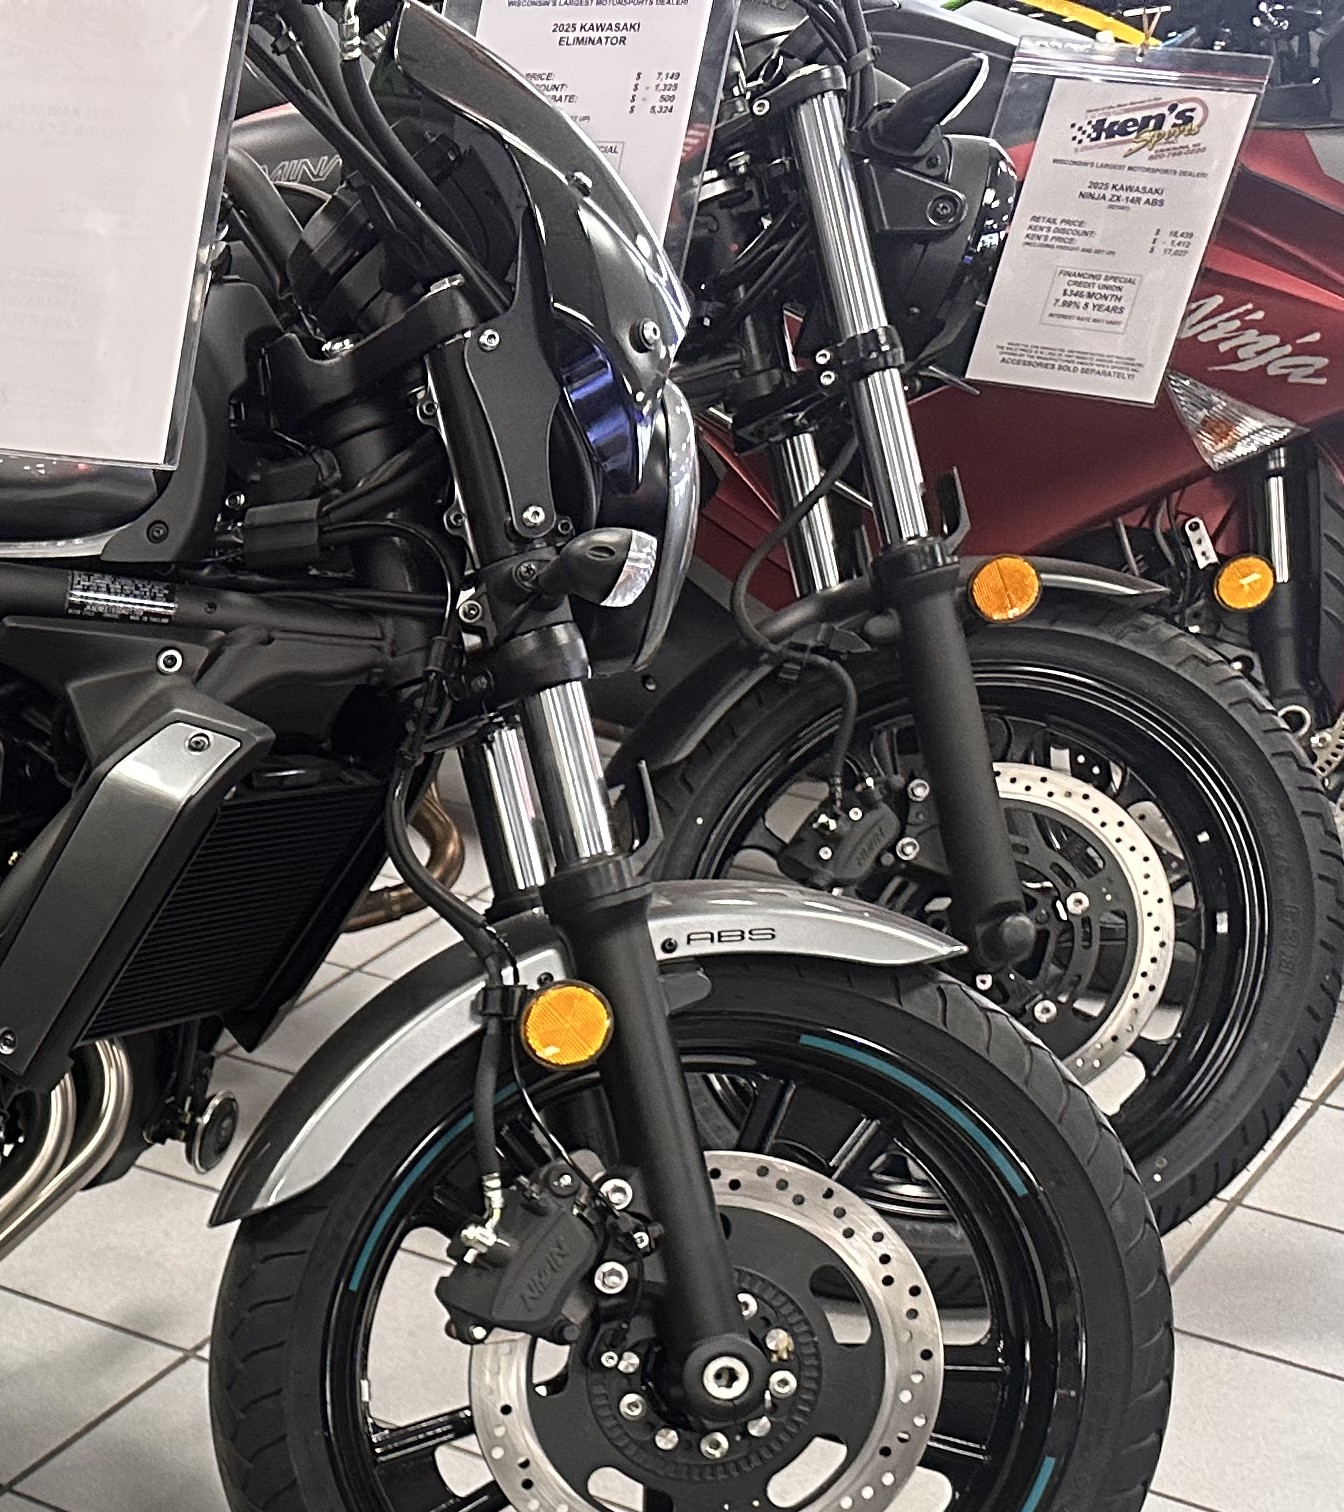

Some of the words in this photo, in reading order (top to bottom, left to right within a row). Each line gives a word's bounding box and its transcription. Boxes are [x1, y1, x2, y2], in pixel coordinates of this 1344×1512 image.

[552, 22, 577, 33] 2025
[579, 22, 641, 33] KAWASAKI
[558, 36, 627, 46] ELIMINATOR
[635, 72, 642, 81] $
[656, 72, 680, 82] 7,149
[632, 83, 639, 92] $
[654, 83, 678, 93] 1,325
[630, 94, 636, 103] $
[629, 105, 635, 114] $
[649, 105, 673, 115] 5,324
[1095, 161, 1126, 172] LARGEST
[1127, 164, 1177, 177] MOTORSPORTS
[1088, 181, 1110, 191] 2025
[1111, 182, 1164, 196] KAWASAKI
[1078, 191, 1106, 202] NINJA
[1109, 193, 1143, 205] ZX-14R
[1144, 196, 1164, 206] ABS
[1030, 215, 1058, 226] RETAIL
[1027, 225, 1052, 234] KEN'S
[1024, 233, 1049, 243] KEN'S
[1058, 269, 1102, 281] FINANCING
[1103, 274, 1137, 285] SPECIAL
[1067, 279, 1096, 289] CREDIT
[1097, 282, 1123, 292] UNION
[1092, 303, 1125, 315] YEARS
[1177, 294, 1329, 385] Ninja
[1000, 357, 1056, 371] ACCESSORIES
[1057, 364, 1079, 374] SOLD
[687, 927, 776, 946] ABS
